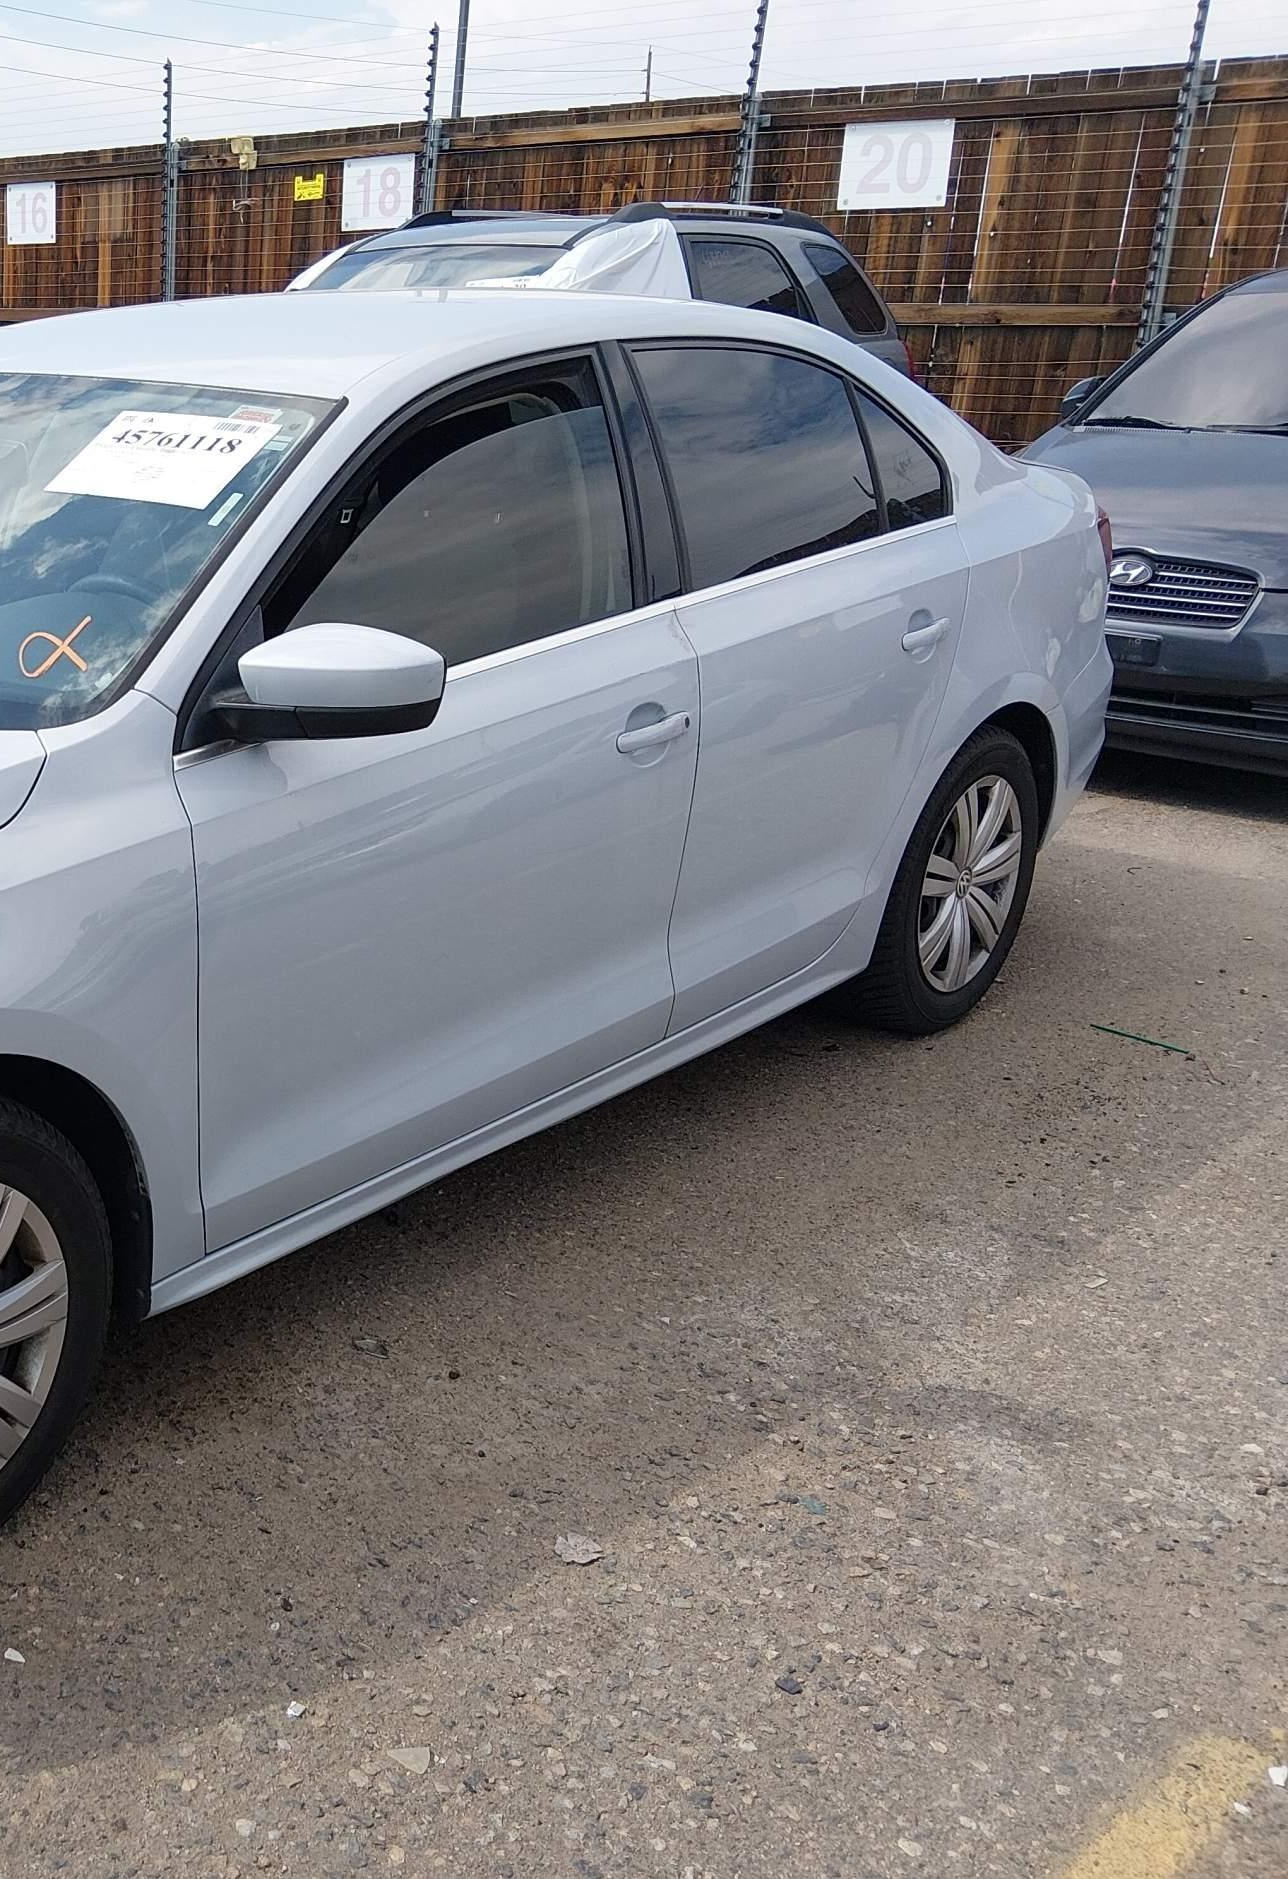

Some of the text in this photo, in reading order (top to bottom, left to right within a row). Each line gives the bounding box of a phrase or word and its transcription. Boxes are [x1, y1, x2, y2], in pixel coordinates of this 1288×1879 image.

[855, 131, 933, 194] 20
[15, 191, 49, 235] 16
[355, 166, 401, 218] 18
[111, 429, 243, 454] 45761118
